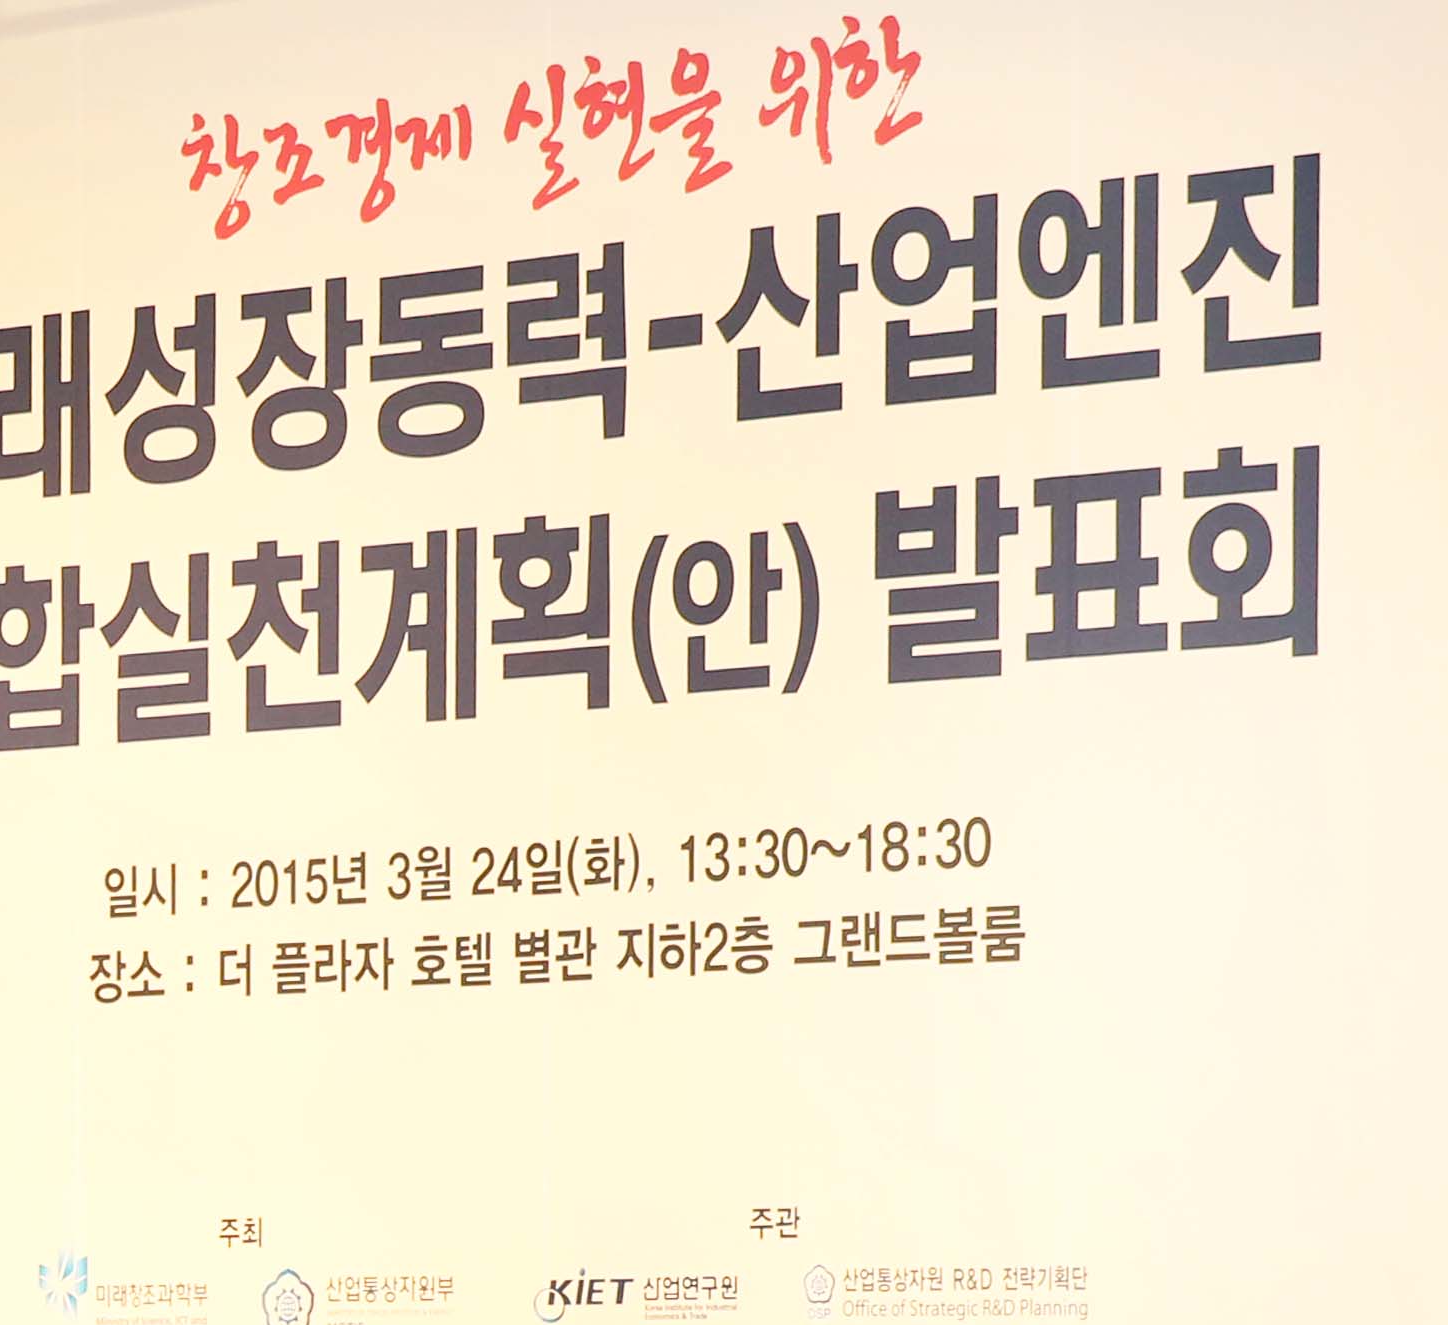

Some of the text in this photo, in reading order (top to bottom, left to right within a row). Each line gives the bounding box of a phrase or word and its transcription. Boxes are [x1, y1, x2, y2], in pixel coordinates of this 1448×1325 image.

[181, 15, 923, 240] 창조경제 실현을 위한
[875, 445, 1319, 684] 발표회
[105, 864, 175, 918] 일시
[232, 852, 366, 908] 2015년
[388, 846, 451, 901] 3월
[472, 833, 654, 896] 24일(화),
[681, 817, 991, 882] 13:30~18:30
[90, 951, 165, 1003] 장소
[220, 944, 251, 996] 더
[272, 937, 394, 994] 플라자
[412, 932, 491, 986] 호텔
[515, 927, 596, 984] 별관
[617, 917, 773, 978] 지하2층
[794, 906, 1025, 967] 그랜드볼룸
[219, 1218, 261, 1248] 주최
[750, 1208, 799, 1239] 주관
[842, 1300, 886, 1317] Office
[910, 1299, 979, 1321] Strategic
[983, 1299, 1015, 1316] R&D
[1020, 1299, 1088, 1320] Planning
[843, 1266, 1088, 1293] 산업통상자원 R&D 전략기획단
